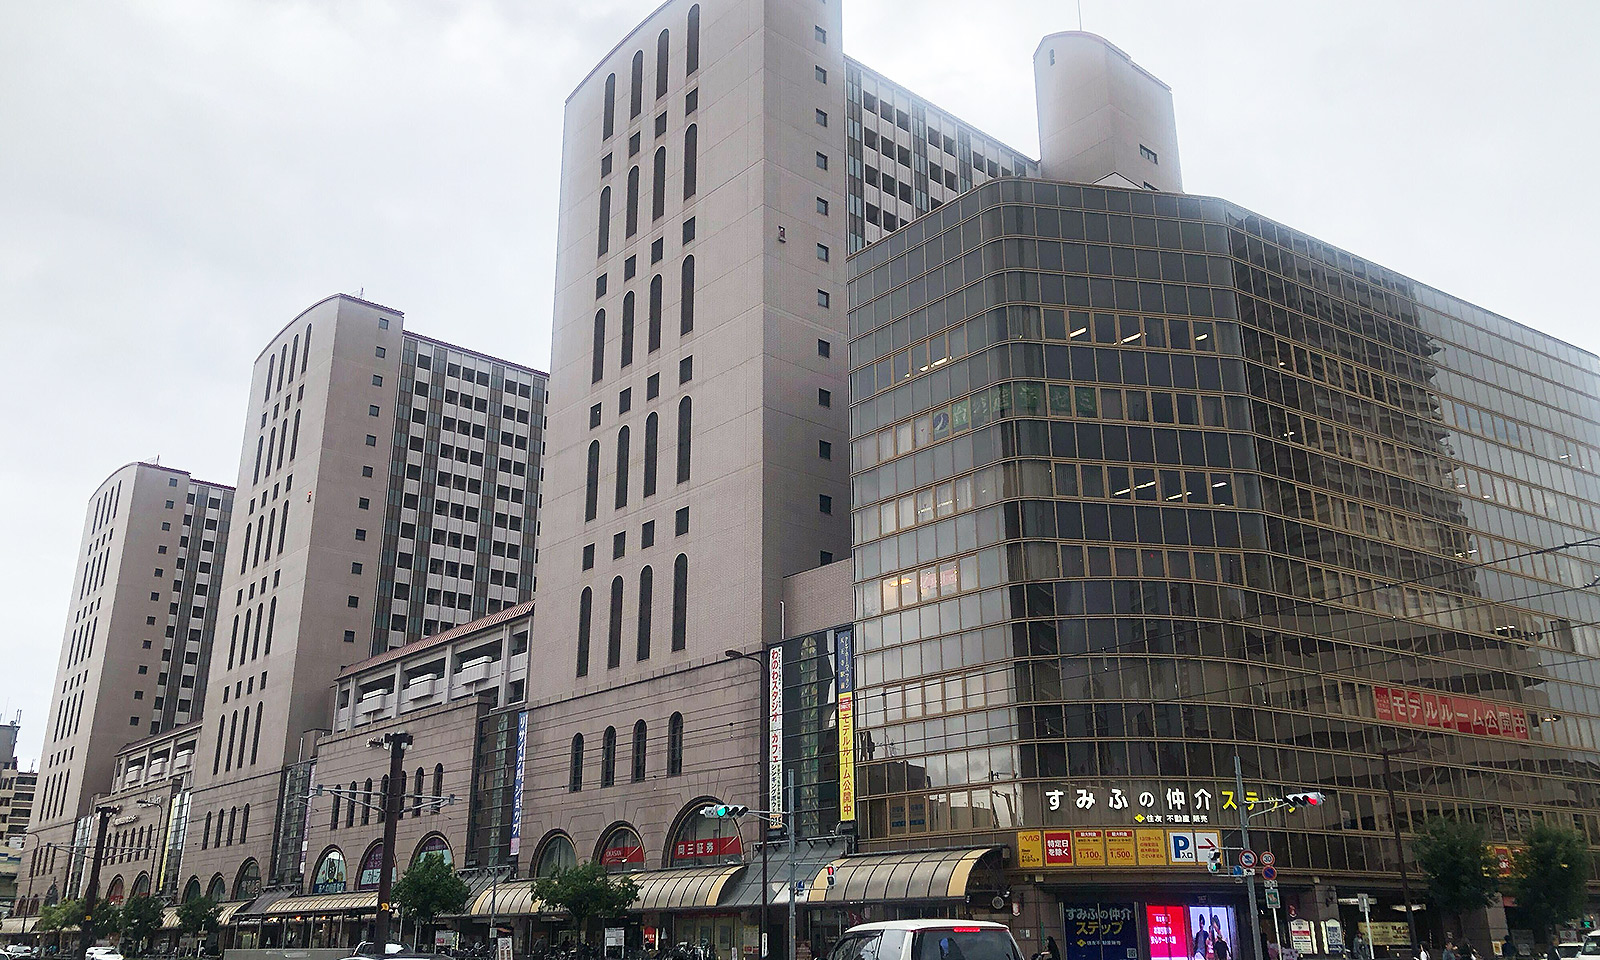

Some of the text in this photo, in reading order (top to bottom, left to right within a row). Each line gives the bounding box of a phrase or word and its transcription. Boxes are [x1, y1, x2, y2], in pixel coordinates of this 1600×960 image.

[771, 649, 779, 722] わのわスタジオ
[1393, 696, 1526, 733] モデルルーム公開中
[842, 713, 852, 816] モデルルーム公開中
[1047, 839, 1069, 848] 特定日
[1049, 848, 1069, 857] を除く
[1173, 835, 1190, 858] P
[1066, 908, 1132, 921] すみふの仲介
[1076, 921, 1124, 935] ステップ
